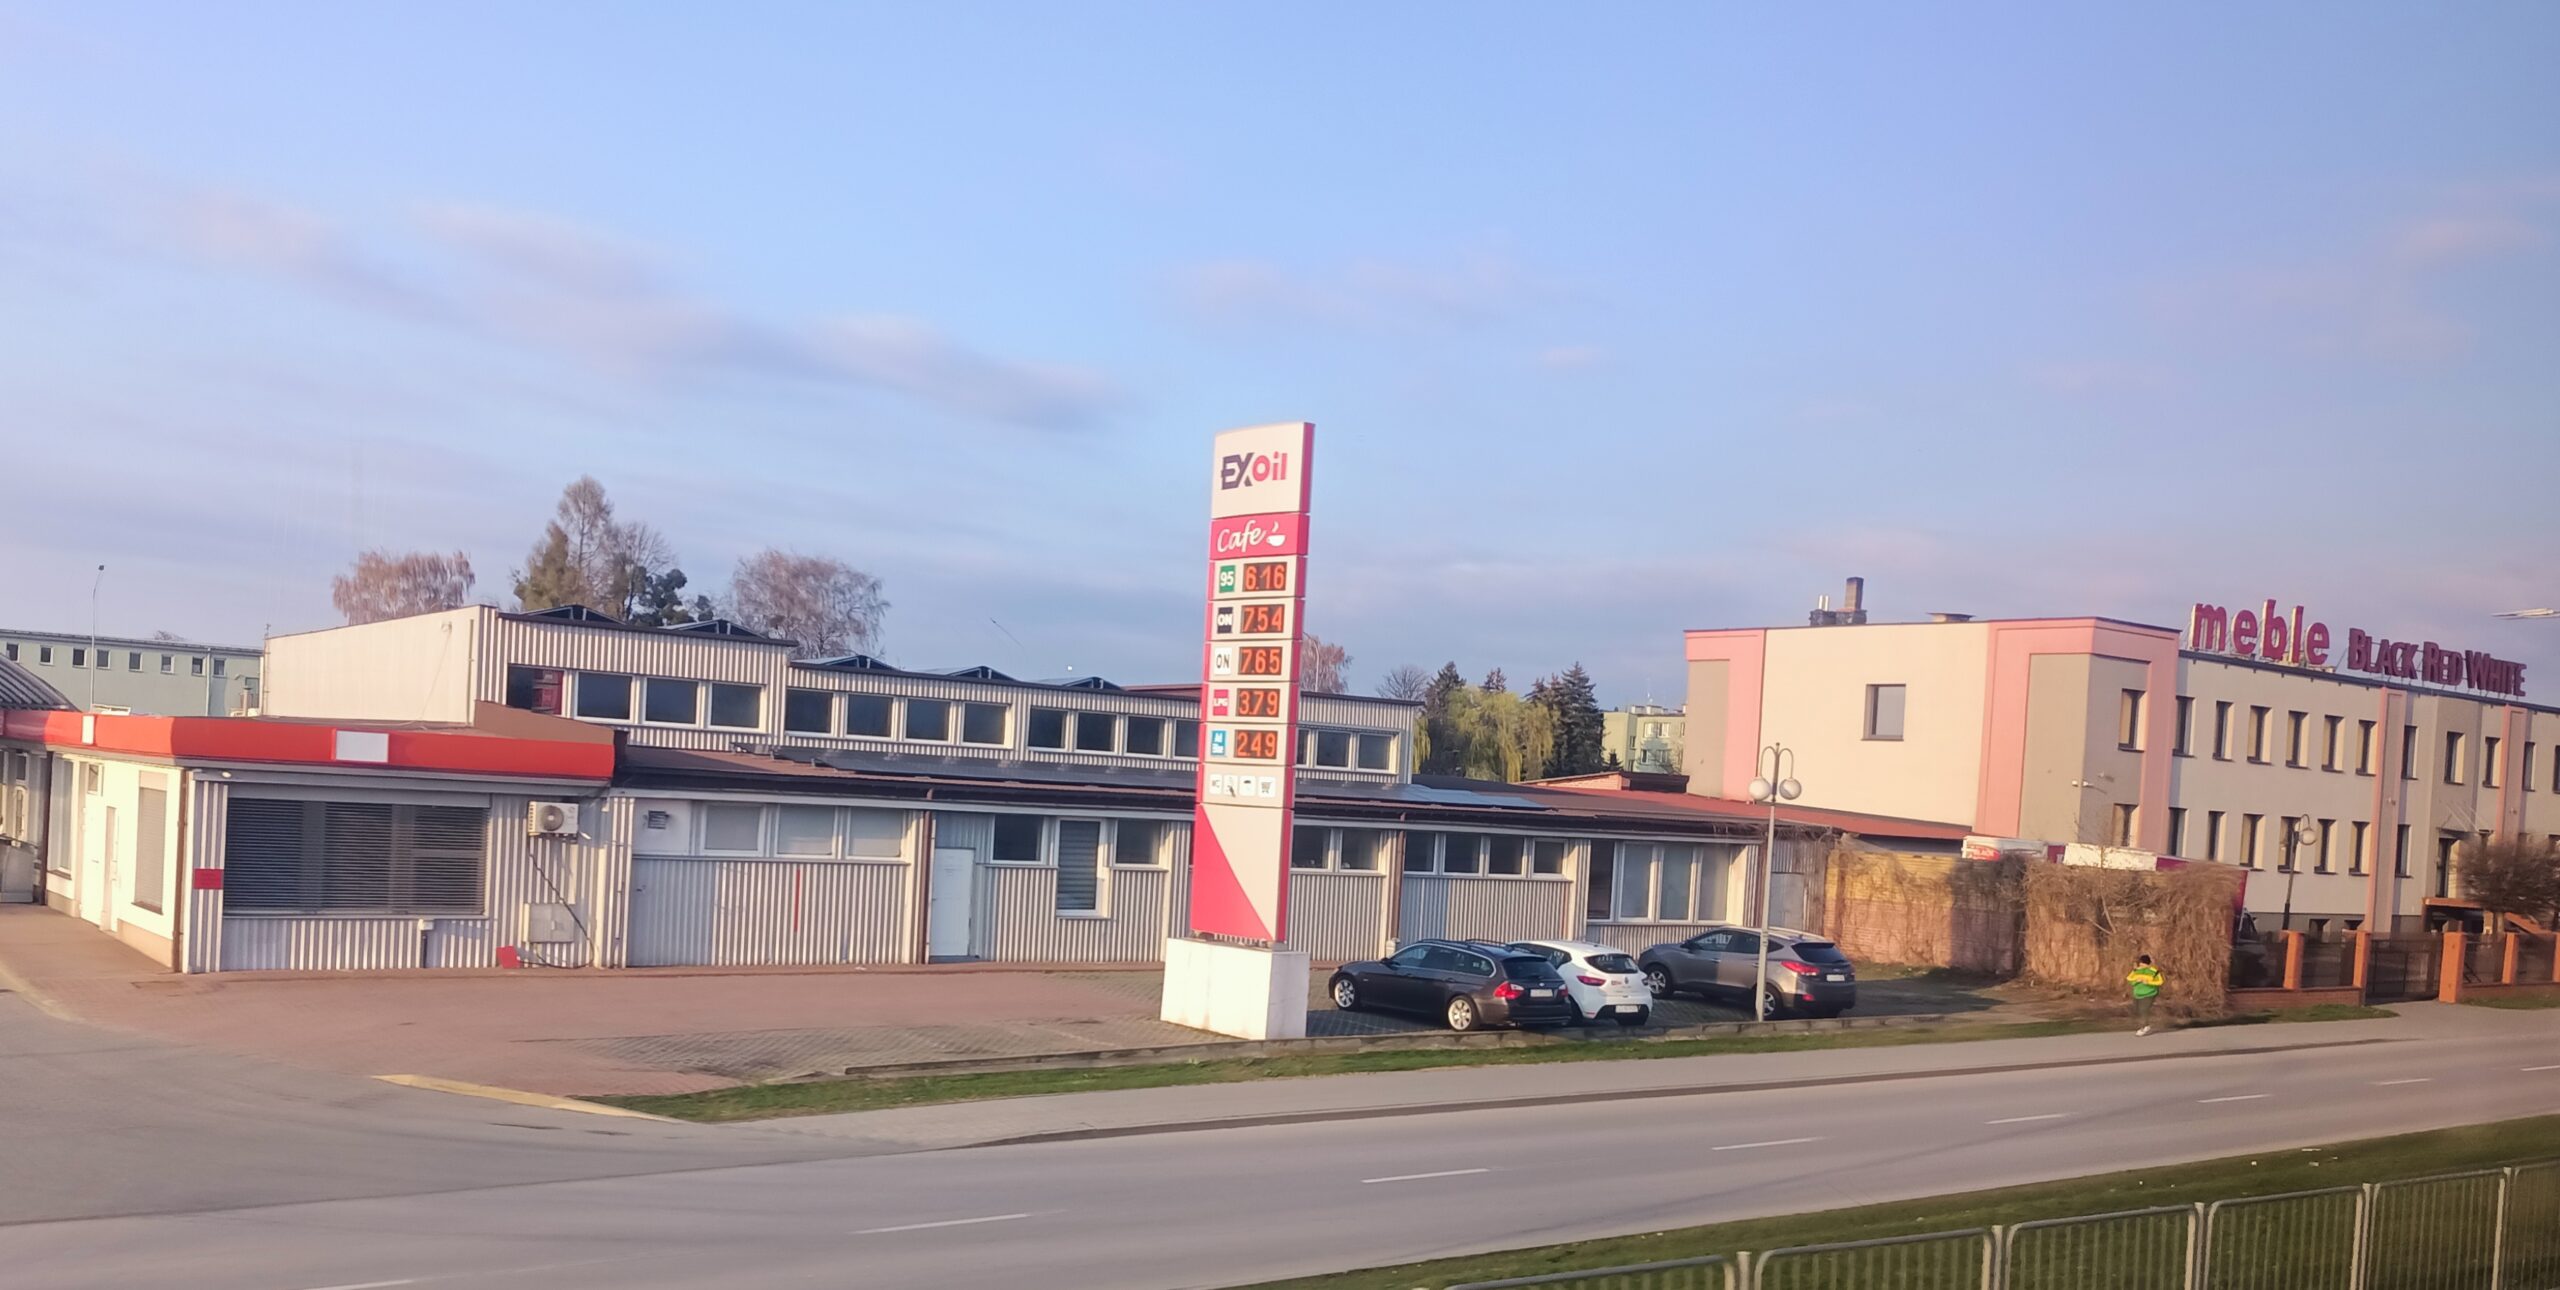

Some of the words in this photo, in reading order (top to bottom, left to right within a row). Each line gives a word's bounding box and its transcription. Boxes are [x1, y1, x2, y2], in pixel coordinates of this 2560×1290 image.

[1217, 519, 1267, 552] Cafe
[1220, 571, 1234, 587] 95
[1245, 564, 1285, 590] 6.16
[1217, 613, 1232, 626] ON
[1242, 606, 1283, 632] 7.54
[2190, 599, 2330, 665] meble
[1216, 654, 1231, 669] ON
[1241, 648, 1281, 673] 7.65
[2348, 627, 2419, 679] BLACK
[2422, 641, 2463, 686] RED
[2465, 650, 2527, 697] WHITE
[1239, 690, 1278, 715] 3.79
